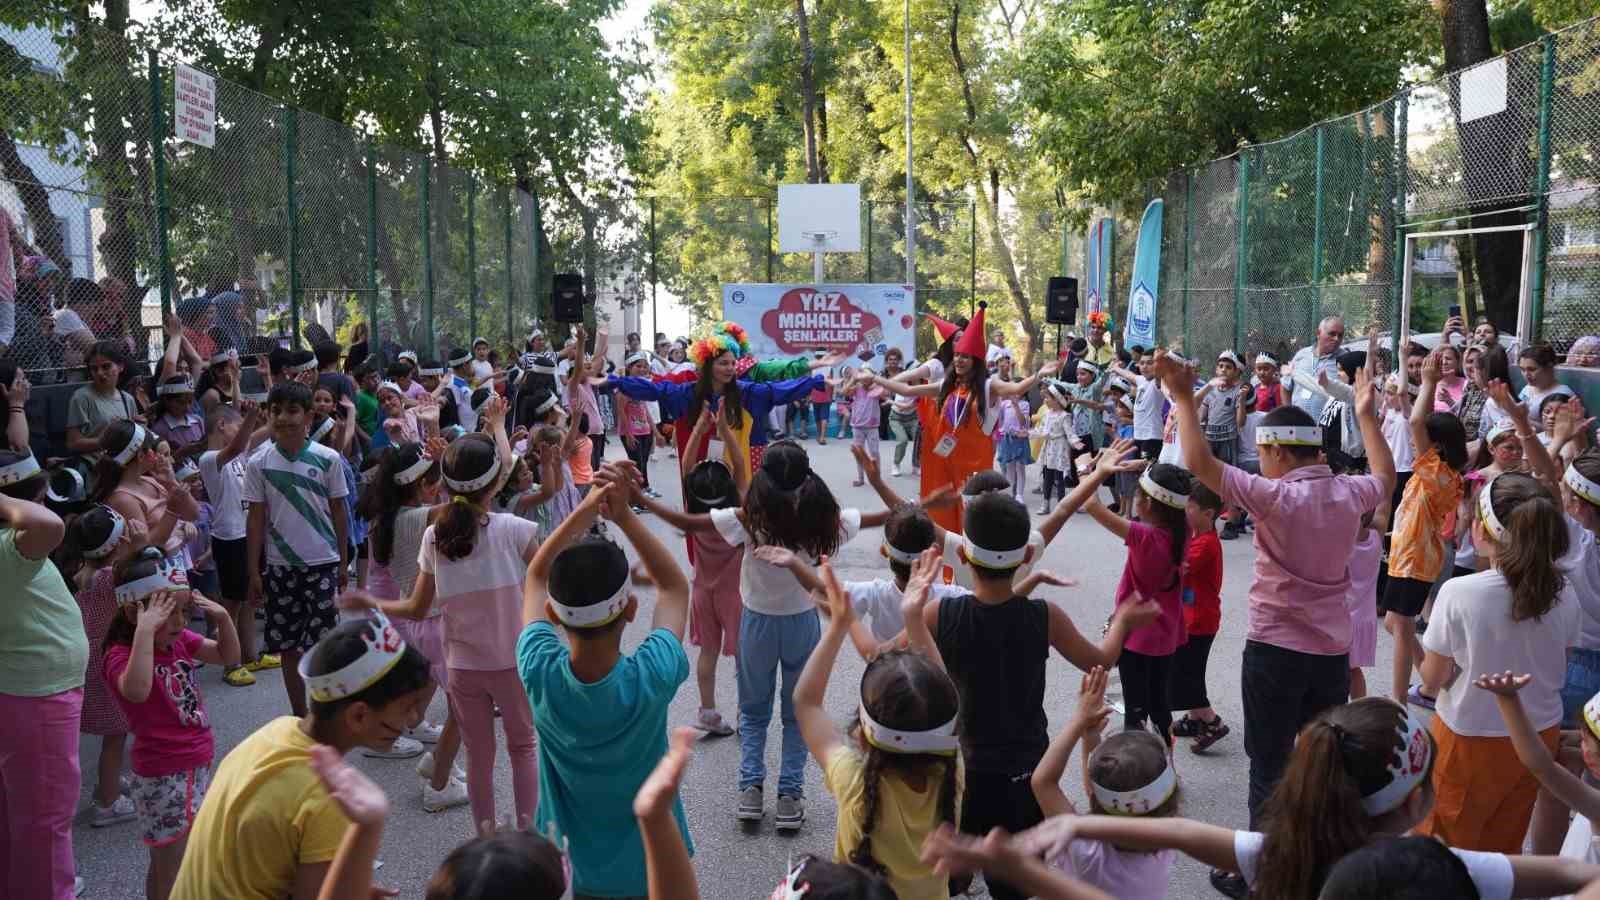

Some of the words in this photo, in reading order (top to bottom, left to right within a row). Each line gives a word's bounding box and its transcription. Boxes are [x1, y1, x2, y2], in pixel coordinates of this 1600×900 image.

[800, 293, 841, 312] YAZ
[778, 313, 862, 329] MAHALLE
[783, 330, 858, 343] ŞENLİKLERİ
